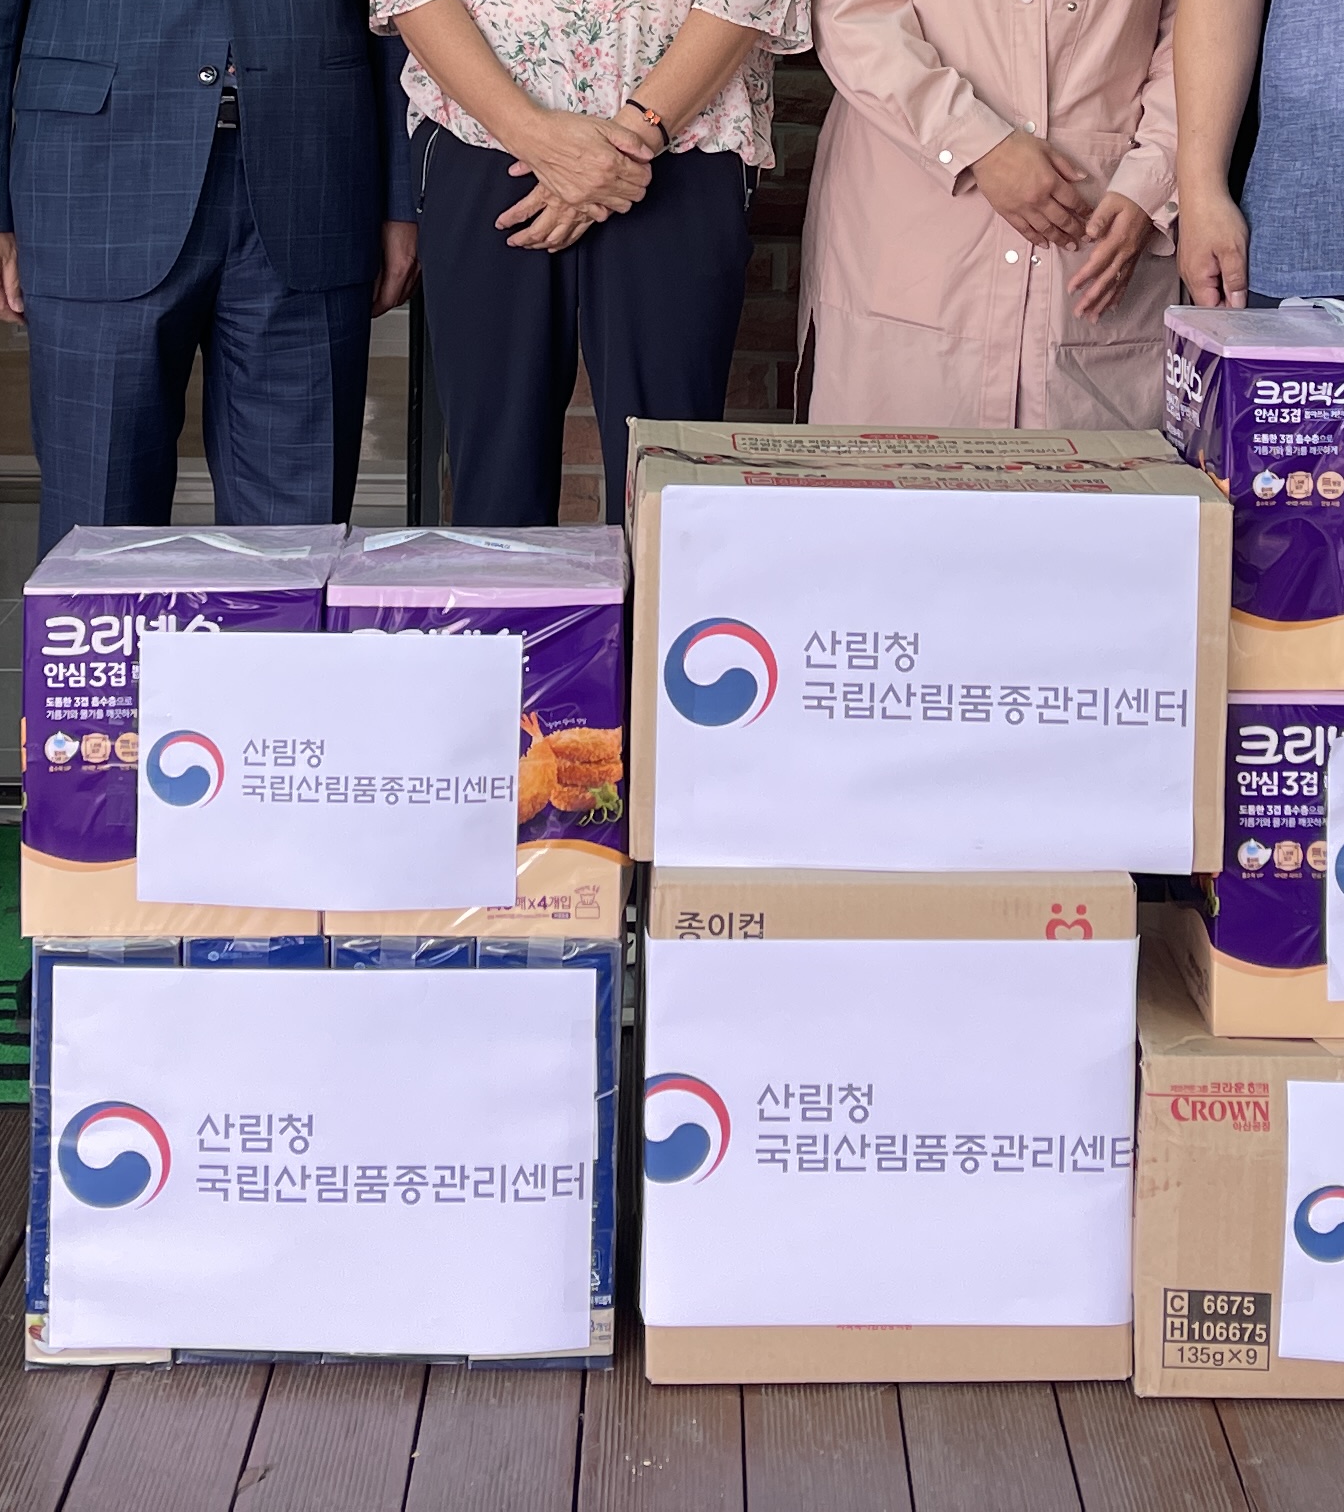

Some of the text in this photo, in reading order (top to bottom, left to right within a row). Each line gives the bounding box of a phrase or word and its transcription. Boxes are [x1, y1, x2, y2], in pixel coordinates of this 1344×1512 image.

[803, 630, 919, 673] 산림청
[44, 662, 127, 688] 안심 3겹
[802, 681, 1188, 728] 국립산림품종관리센터
[242, 738, 325, 768] 산림청
[241, 774, 514, 806] 국립산림품종관리센터
[1237, 771, 1318, 796] 안심 3겹
[674, 911, 764, 940] 종이컵
[756, 1082, 874, 1124] 산림청
[1170, 1096, 1269, 1122] CROWN
[196, 1113, 314, 1155] 산림청
[1233, 1121, 1270, 1132] 아산공장
[195, 1161, 585, 1205] 국립산림품종관리센터
[1170, 1294, 1256, 1316] C 6675
[1170, 1320, 1268, 1343] H 106675
